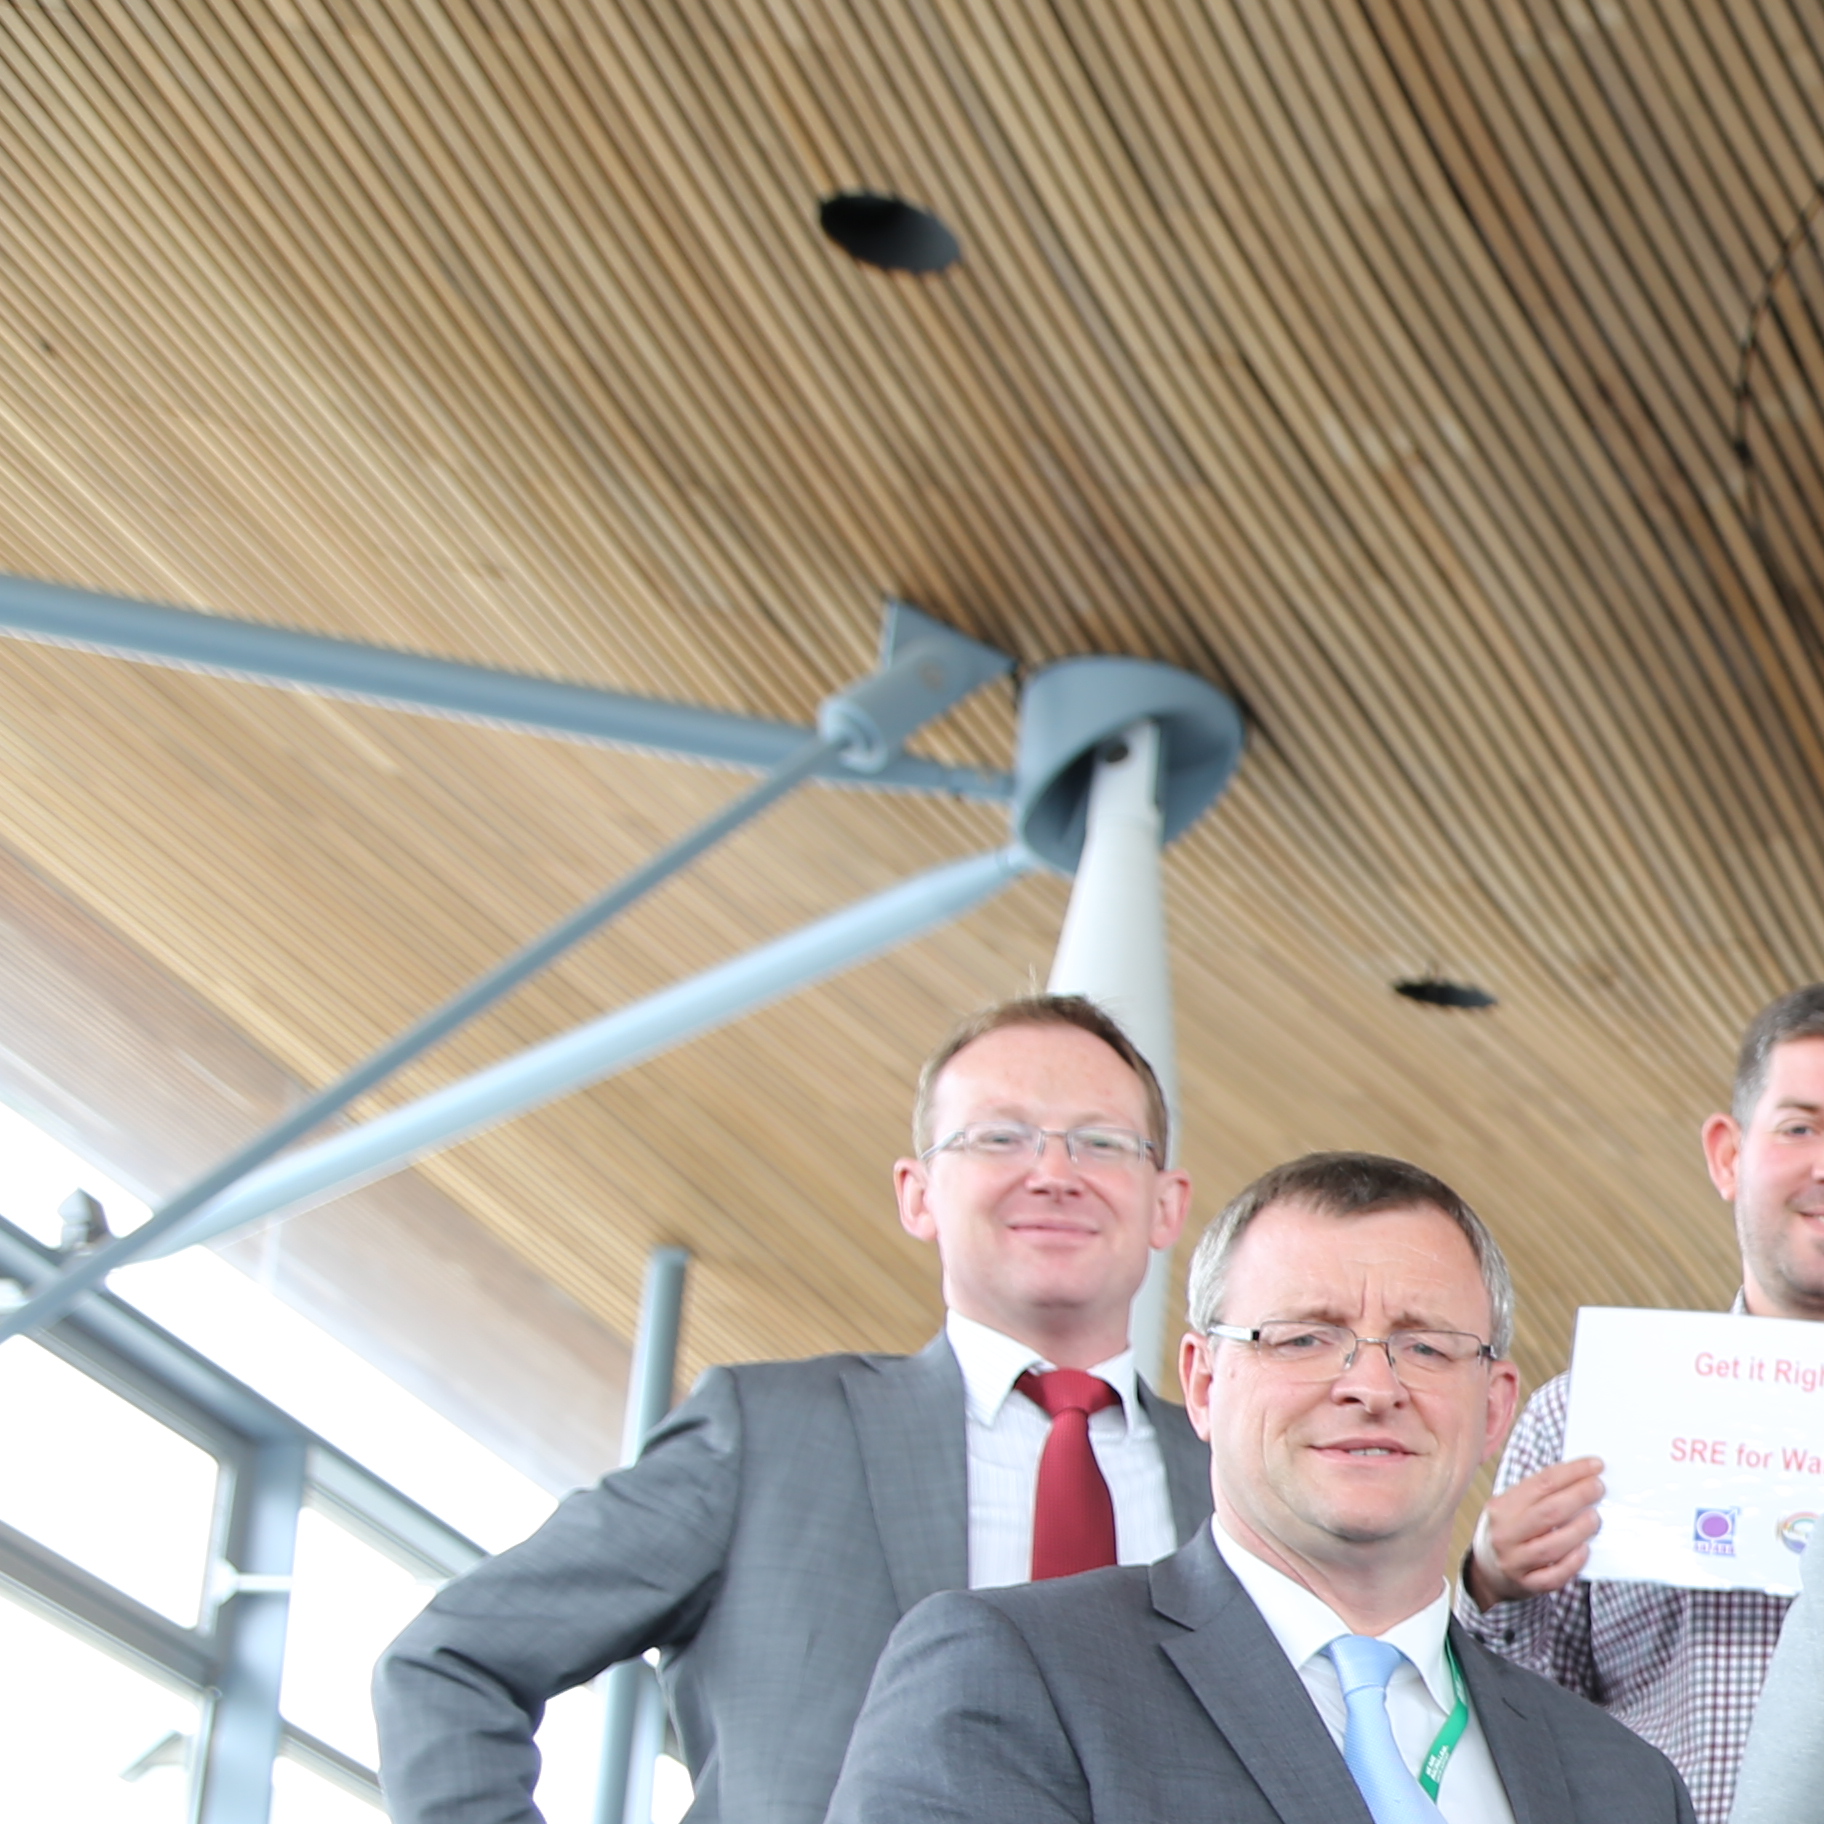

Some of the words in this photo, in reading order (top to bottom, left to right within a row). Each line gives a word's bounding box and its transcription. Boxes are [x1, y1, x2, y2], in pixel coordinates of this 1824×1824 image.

[1694, 1352, 1740, 1380] Get
[1749, 1355, 1766, 1383] it
[1670, 1438, 1726, 1466] SRE
[1736, 1442, 1774, 1470] for
